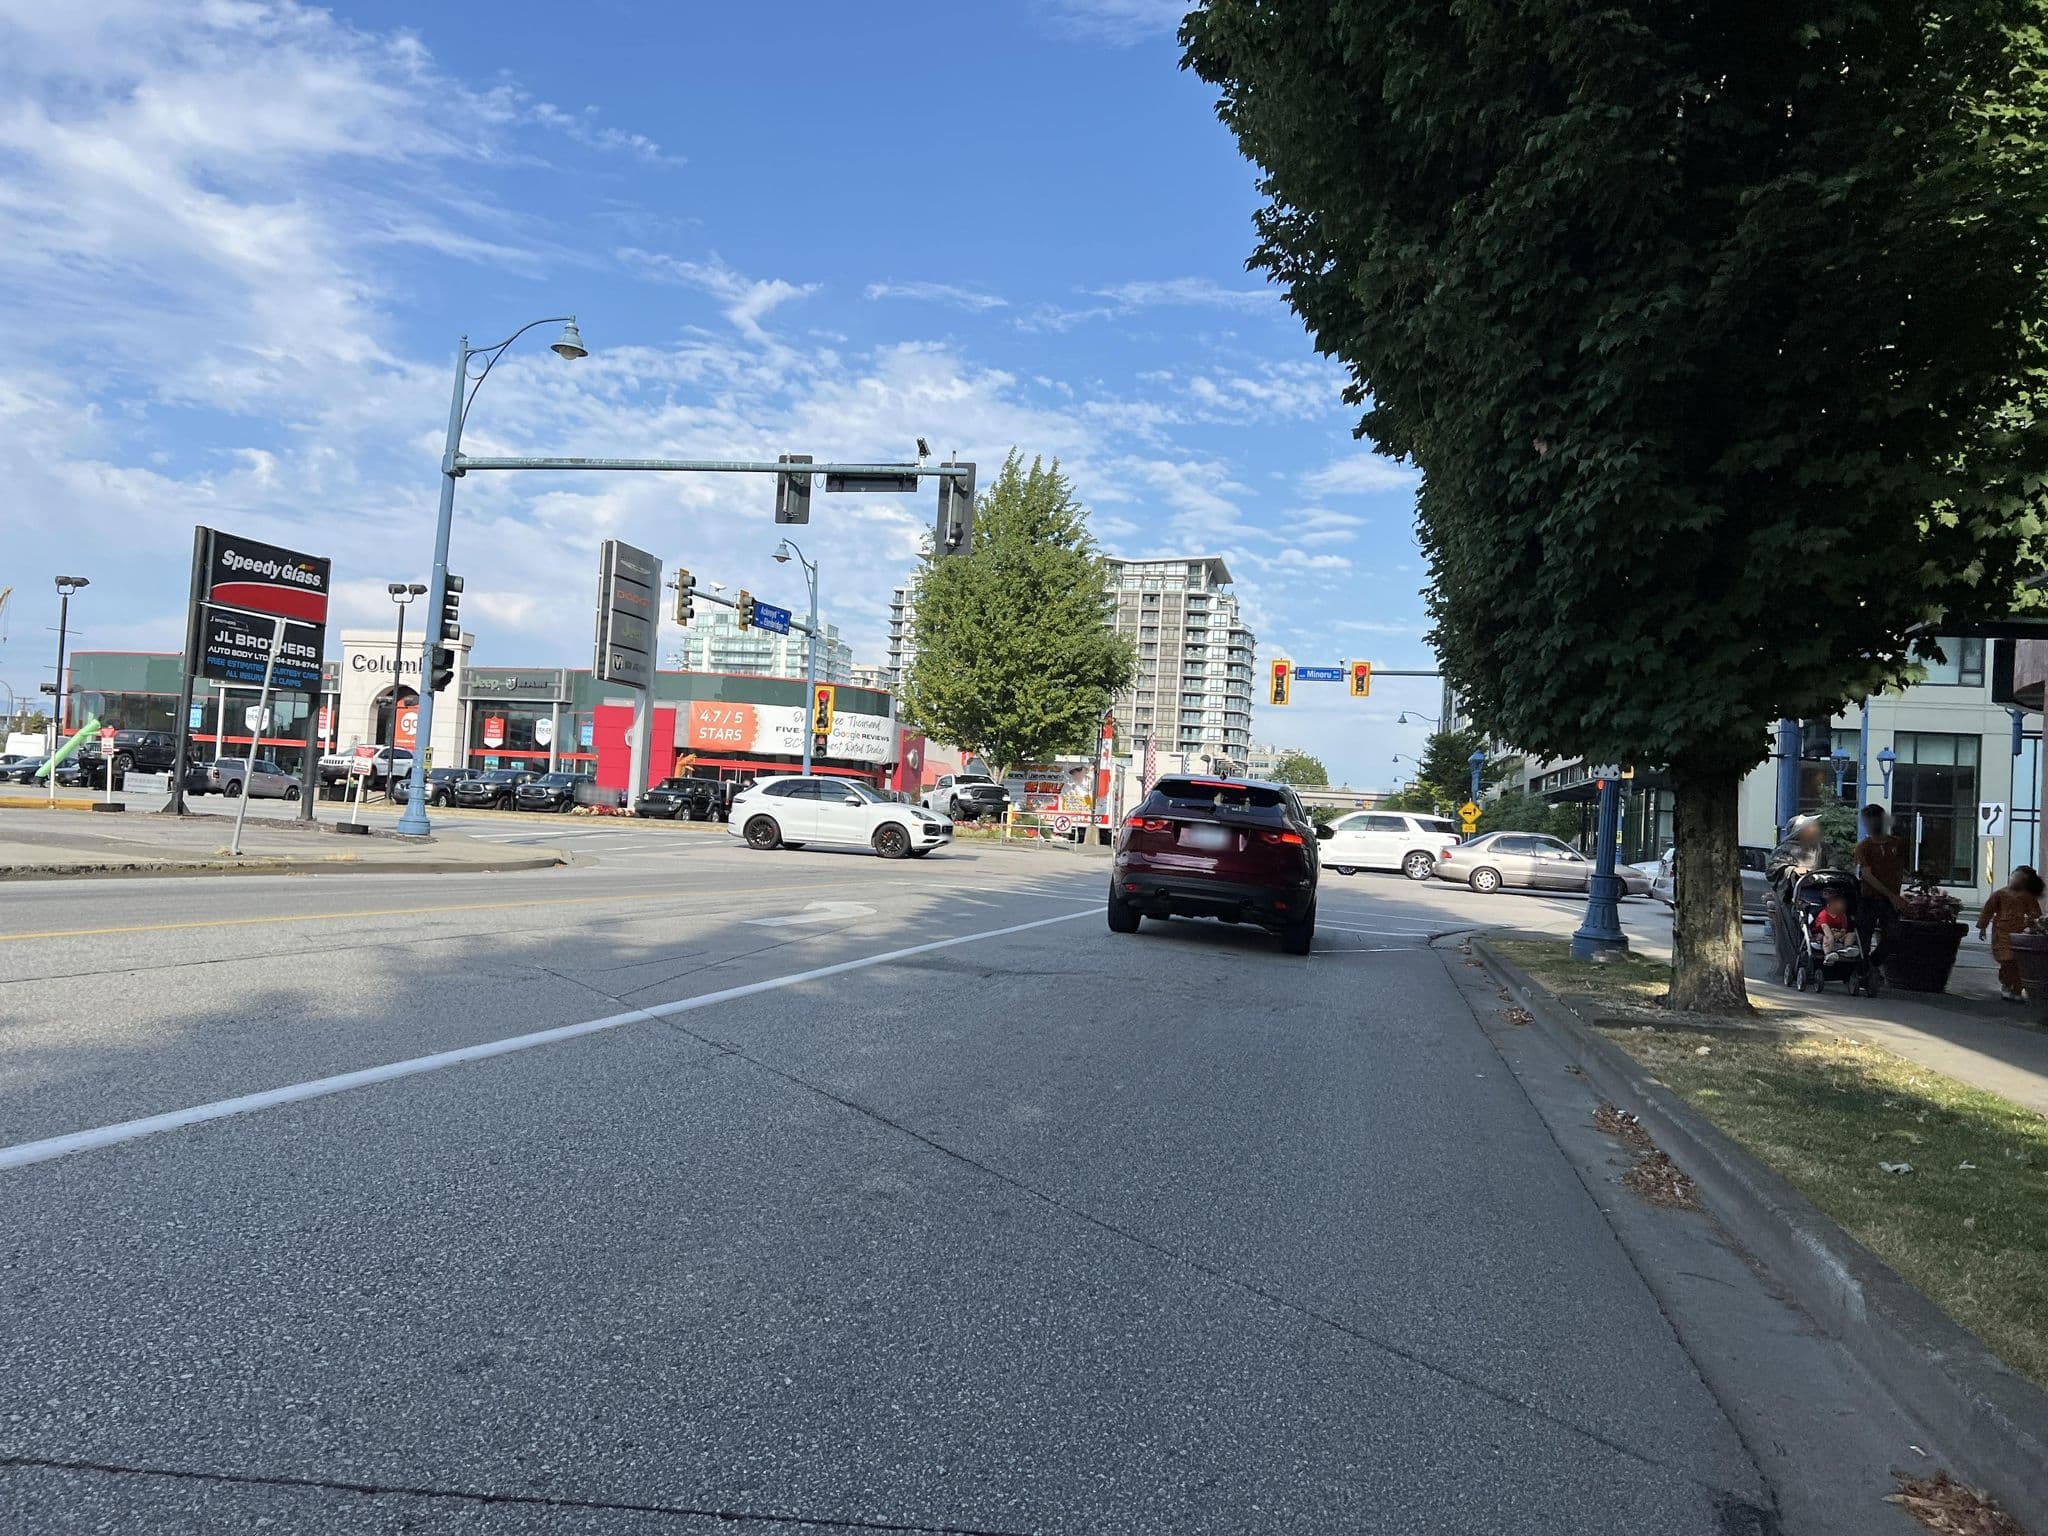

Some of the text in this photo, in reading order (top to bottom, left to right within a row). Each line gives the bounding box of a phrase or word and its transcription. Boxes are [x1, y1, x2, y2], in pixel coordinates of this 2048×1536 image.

[222, 549, 322, 587] Speedy Glass
[214, 630, 233, 645] JL
[208, 645, 231, 656] AUTO
[231, 649, 253, 659] BODY
[254, 653, 269, 661] LTD
[226, 659, 265, 672] ESTIMATES
[272, 666, 301, 679] OURTESY
[352, 653, 423, 674] Colum
[1306, 670, 1332, 679] Minoru
[700, 709, 719, 722] 4.7
[734, 711, 743, 724] 5
[699, 727, 743, 742] STARS
[833, 728, 861, 741] Google
[861, 733, 890, 742] REVIEWS
